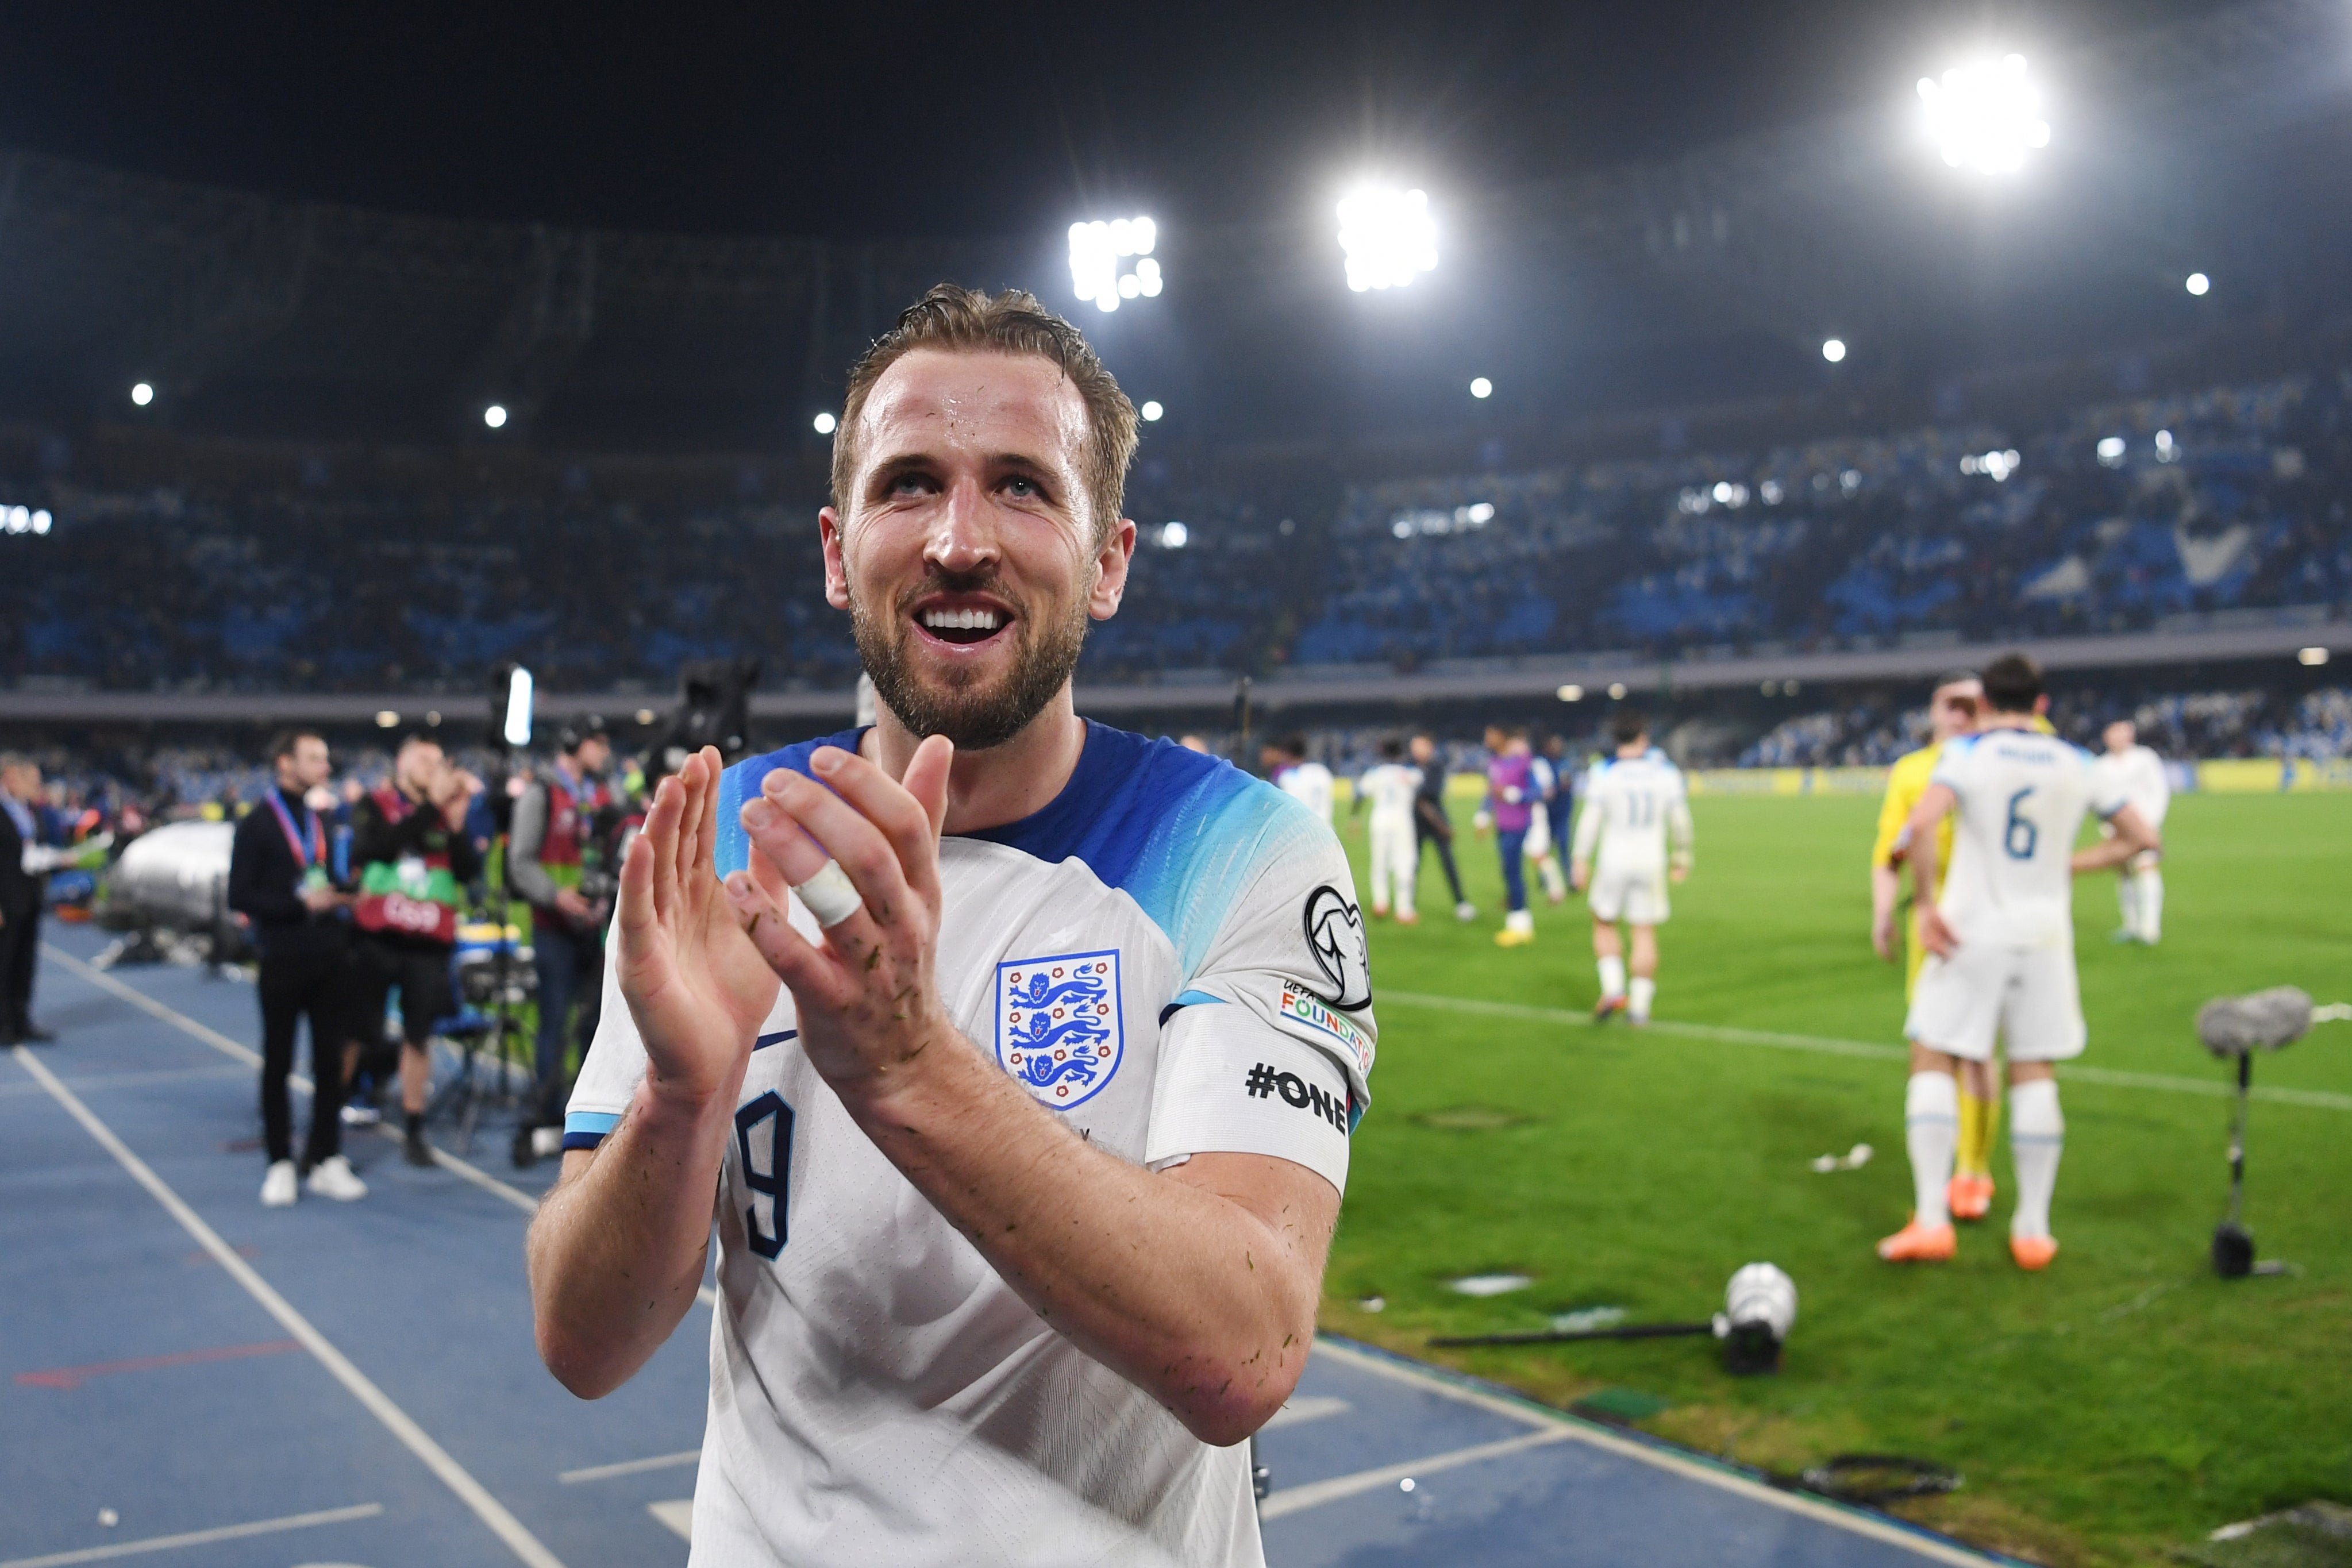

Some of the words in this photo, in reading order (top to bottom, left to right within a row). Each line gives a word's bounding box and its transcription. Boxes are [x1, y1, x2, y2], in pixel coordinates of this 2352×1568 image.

[1625, 789, 1655, 827] 11
[2005, 787, 2037, 860] 6
[1284, 979, 1315, 1000] UEFA
[1281, 992, 1370, 1073] FOUNDATIO
[1245, 1062, 1346, 1137] #ONE
[735, 1088, 795, 1262] 9
